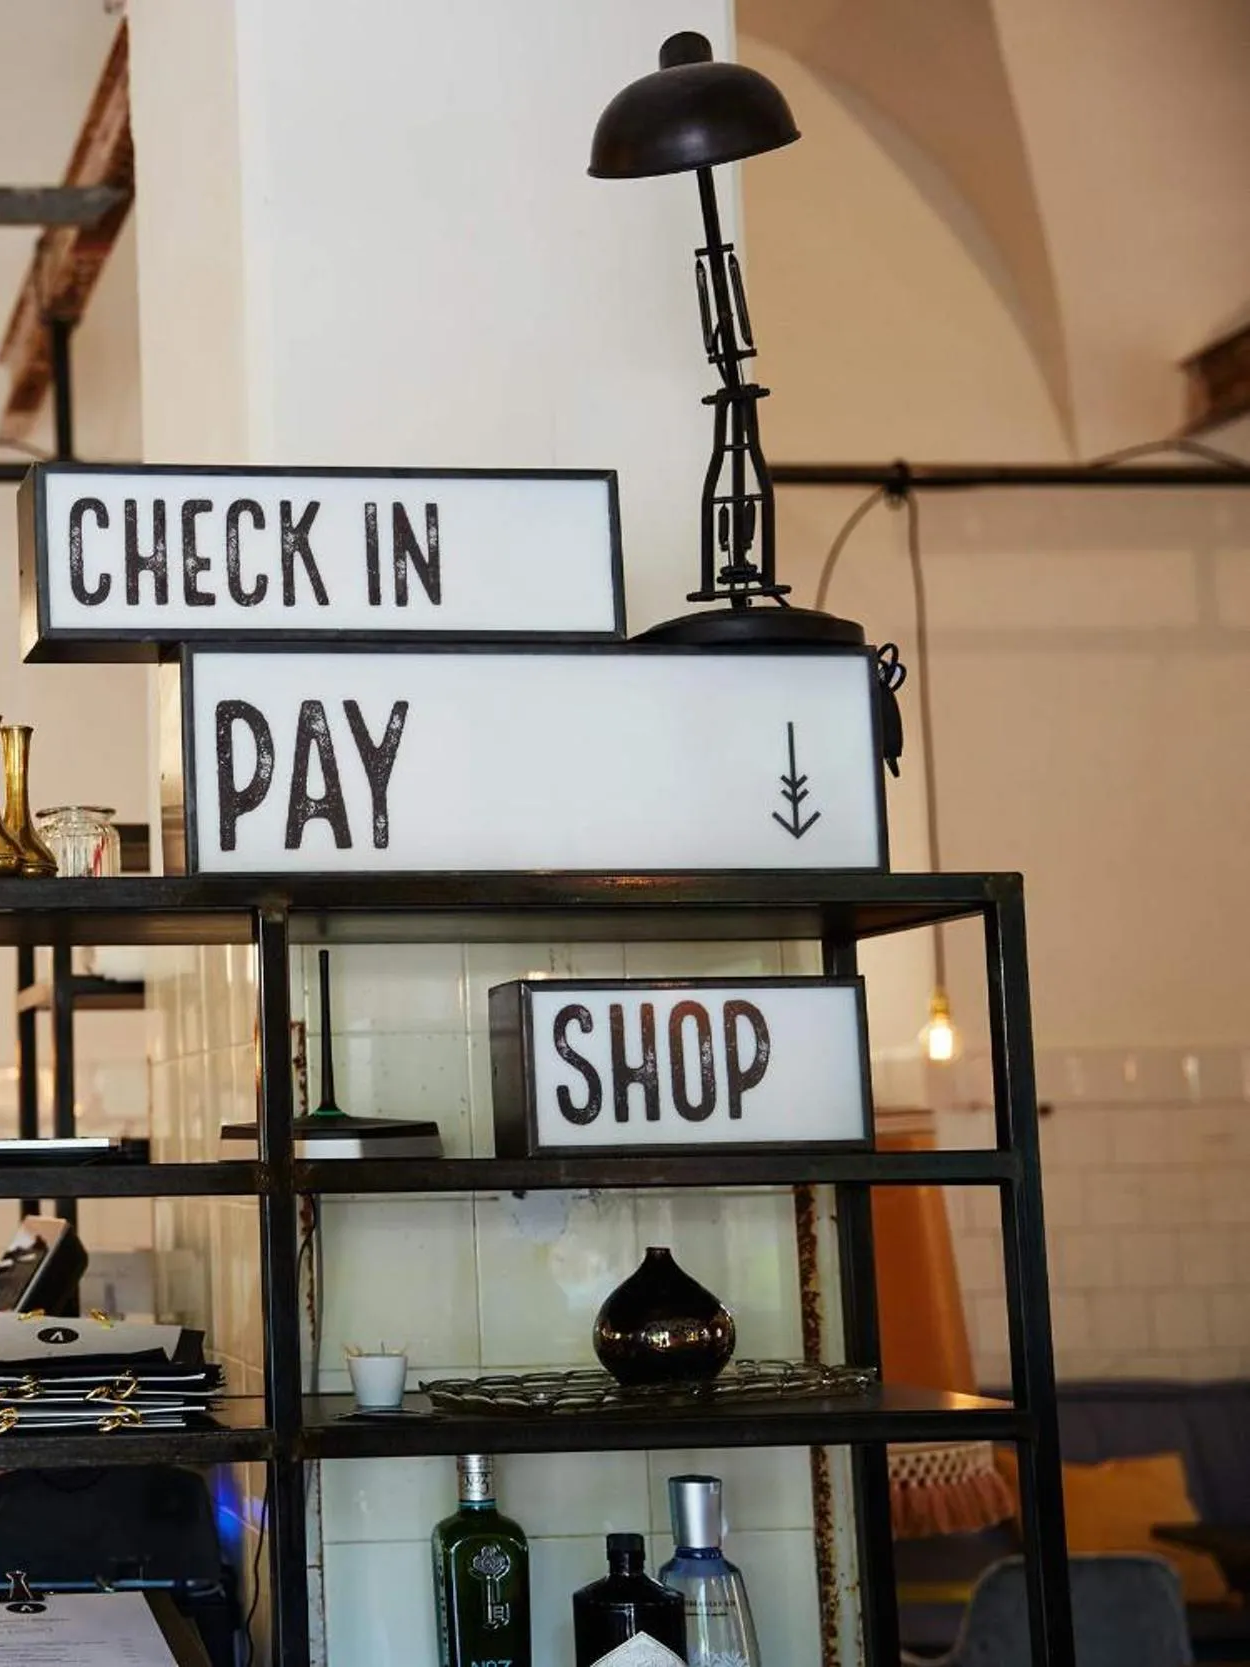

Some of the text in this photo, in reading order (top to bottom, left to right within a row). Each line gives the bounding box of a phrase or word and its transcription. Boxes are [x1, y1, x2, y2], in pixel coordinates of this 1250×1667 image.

[69, 497, 442, 608] CHECK IN
[215, 699, 410, 852] PAY
[552, 998, 770, 1126] SHOP
